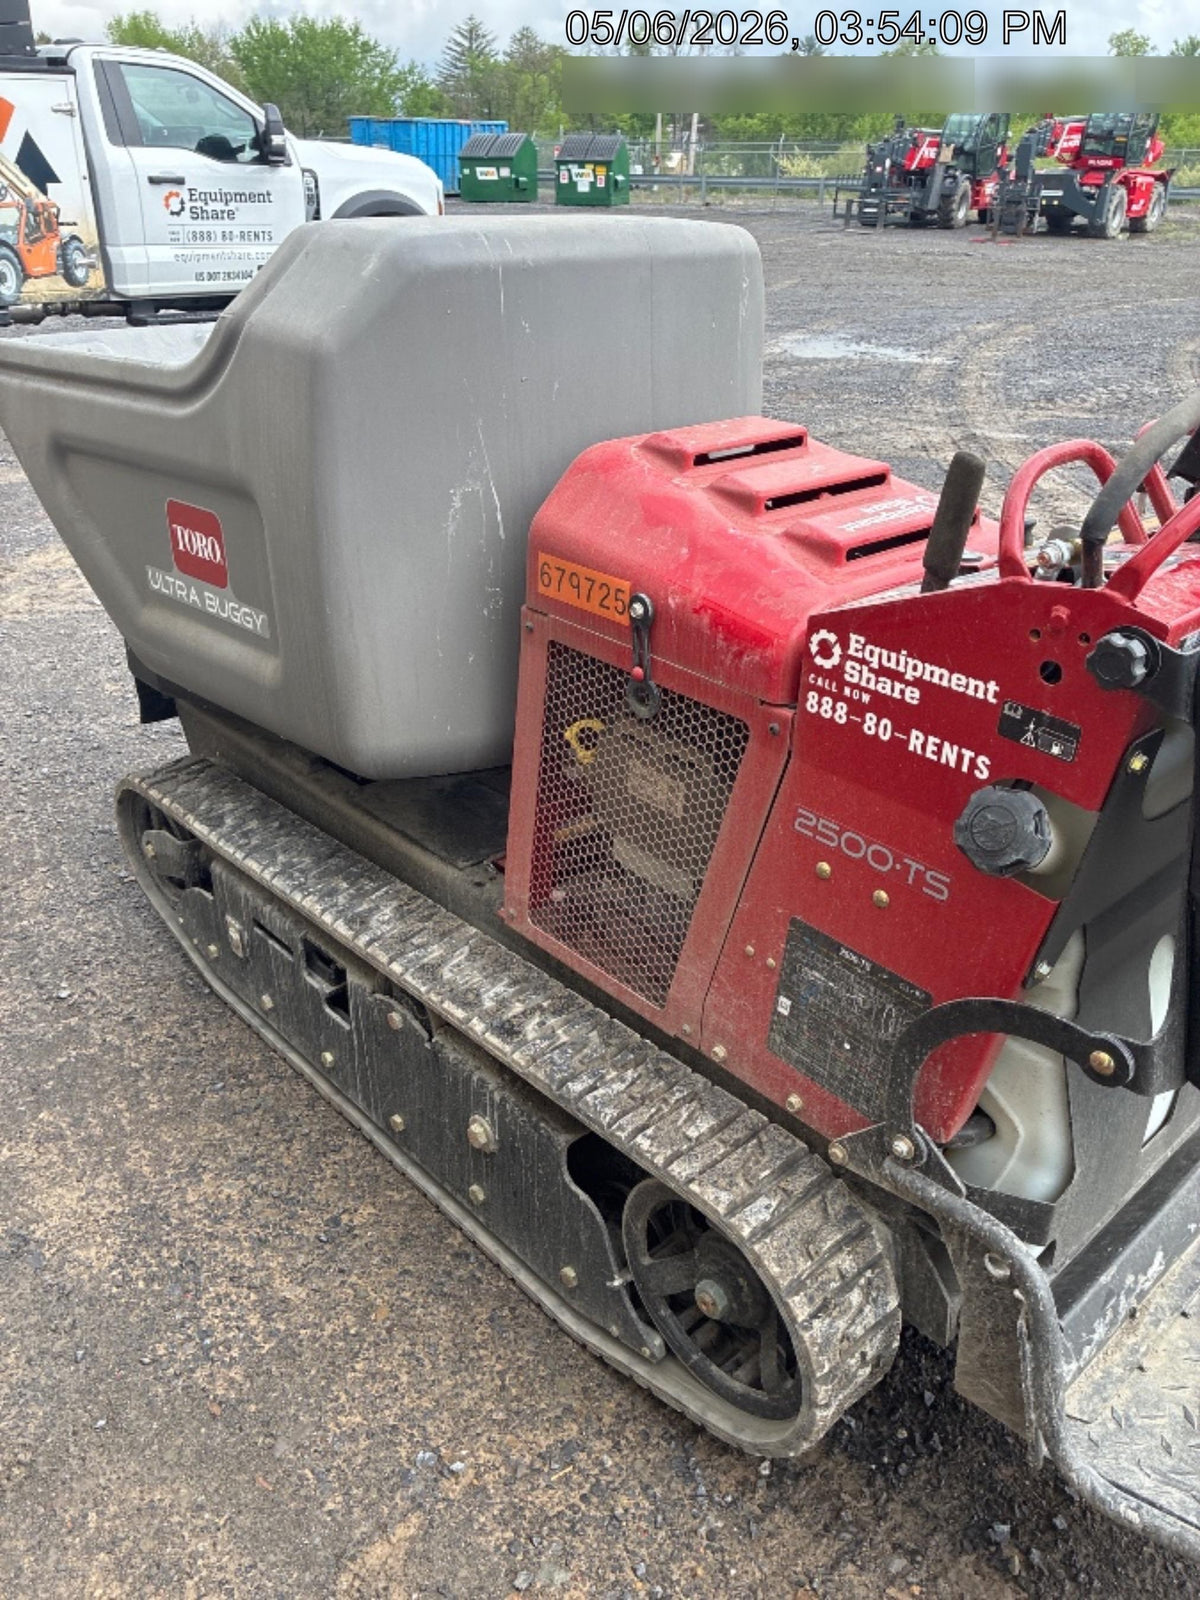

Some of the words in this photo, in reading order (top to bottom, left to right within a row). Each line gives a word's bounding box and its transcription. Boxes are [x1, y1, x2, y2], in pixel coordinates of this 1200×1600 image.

[187, 188, 273, 206] Equipment
[189, 206, 236, 220] Share
[186, 230, 217, 242] (888)
[171, 523, 222, 565] TORO
[147, 567, 202, 608] ULTRA
[204, 591, 266, 634] BUGGY
[540, 561, 627, 616] 679725
[808, 673, 838, 693] CALL
[843, 685, 872, 705] NOW
[843, 660, 921, 705] Share
[847, 632, 1000, 704] Equipment
[805, 690, 992, 780] 888-80-RENTS
